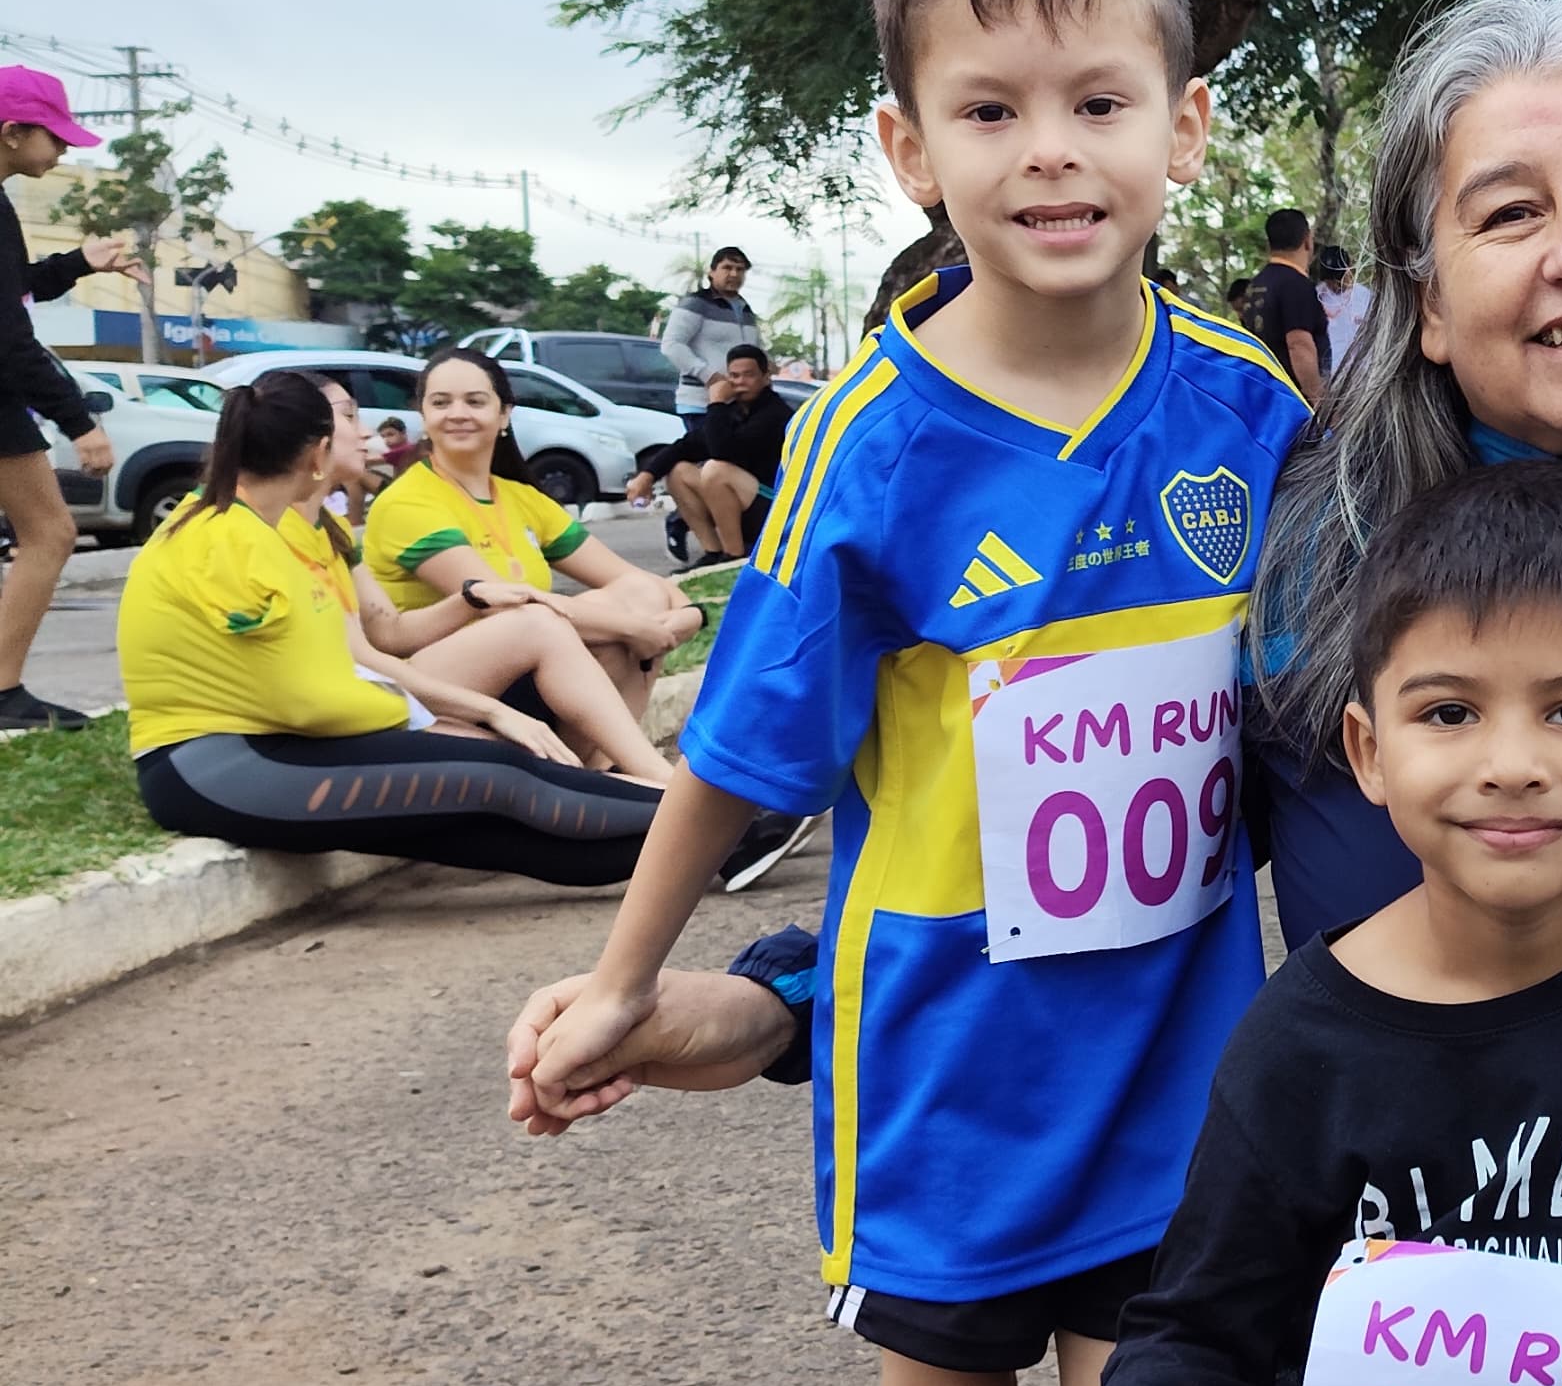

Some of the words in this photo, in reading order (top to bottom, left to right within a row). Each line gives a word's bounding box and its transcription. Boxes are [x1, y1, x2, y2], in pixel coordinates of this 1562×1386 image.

[1181, 507, 1242, 530] CABJ
[1024, 701, 1132, 766] KM
[1152, 677, 1239, 755] RUN
[1025, 756, 1236, 920] 009
[1362, 1299, 1488, 1375] KM
